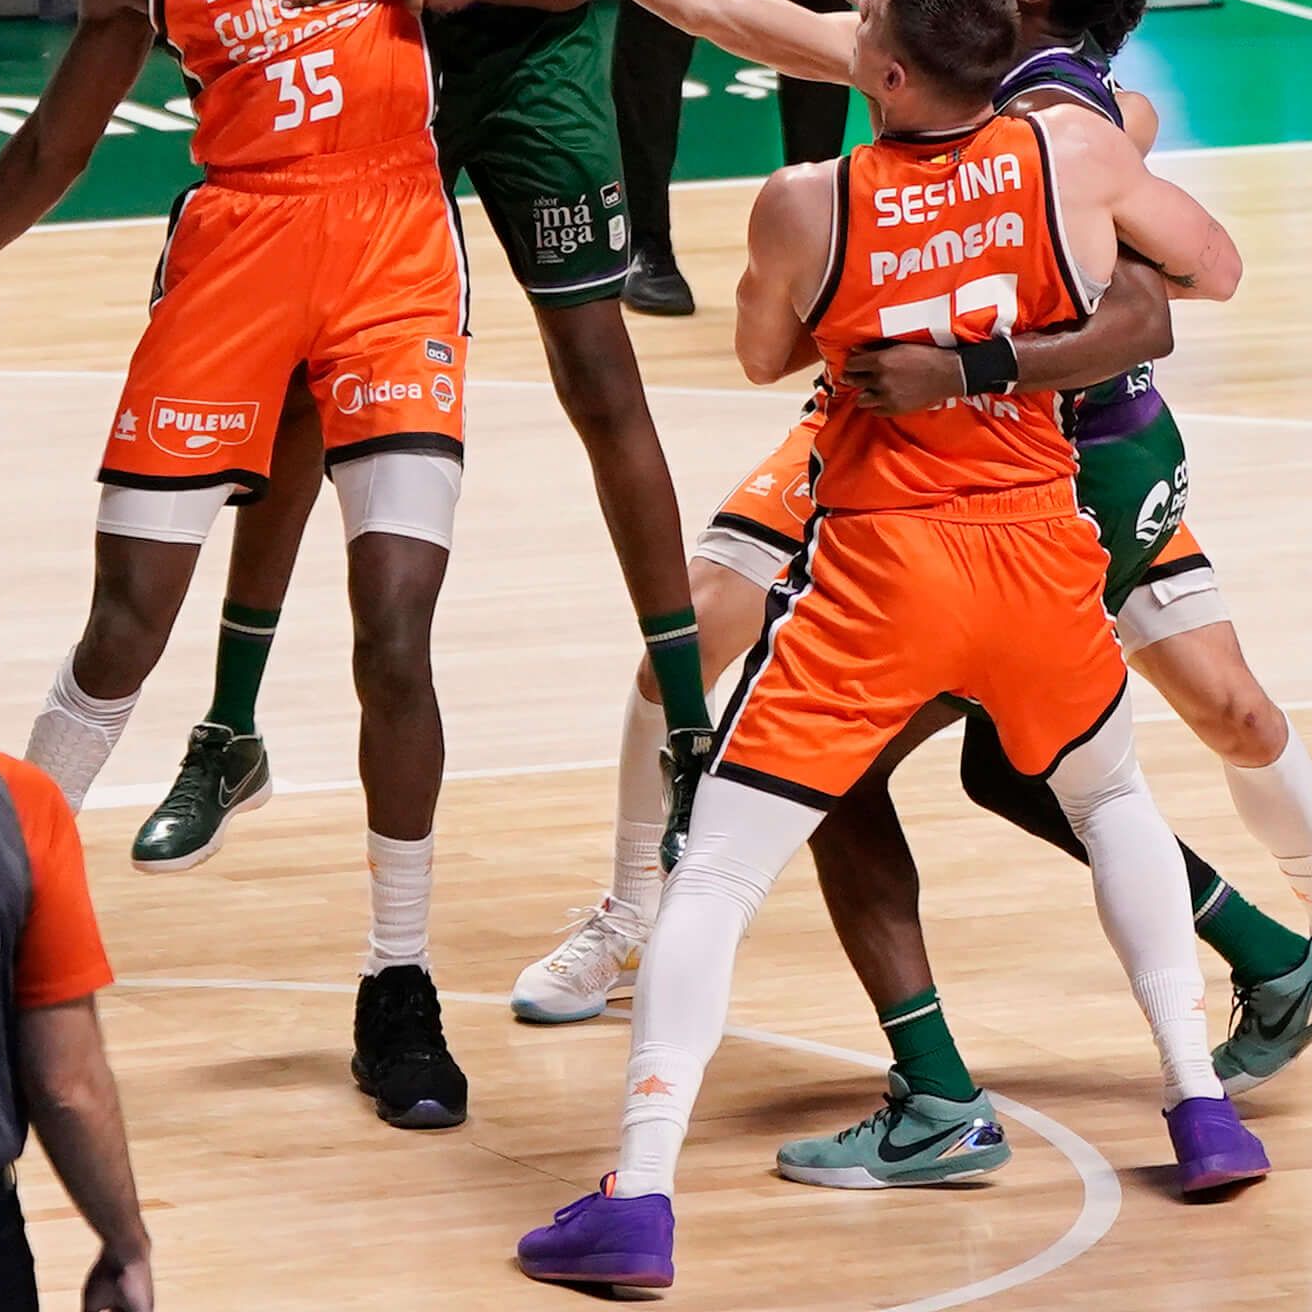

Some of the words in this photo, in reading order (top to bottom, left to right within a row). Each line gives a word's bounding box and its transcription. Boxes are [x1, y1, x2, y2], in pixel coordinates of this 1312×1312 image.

[264, 49, 343, 132] 35
[535, 225, 595, 254] laga
[429, 346, 451, 361] acb
[332, 372, 423, 415] Midea
[157, 407, 247, 431] PULEVA
